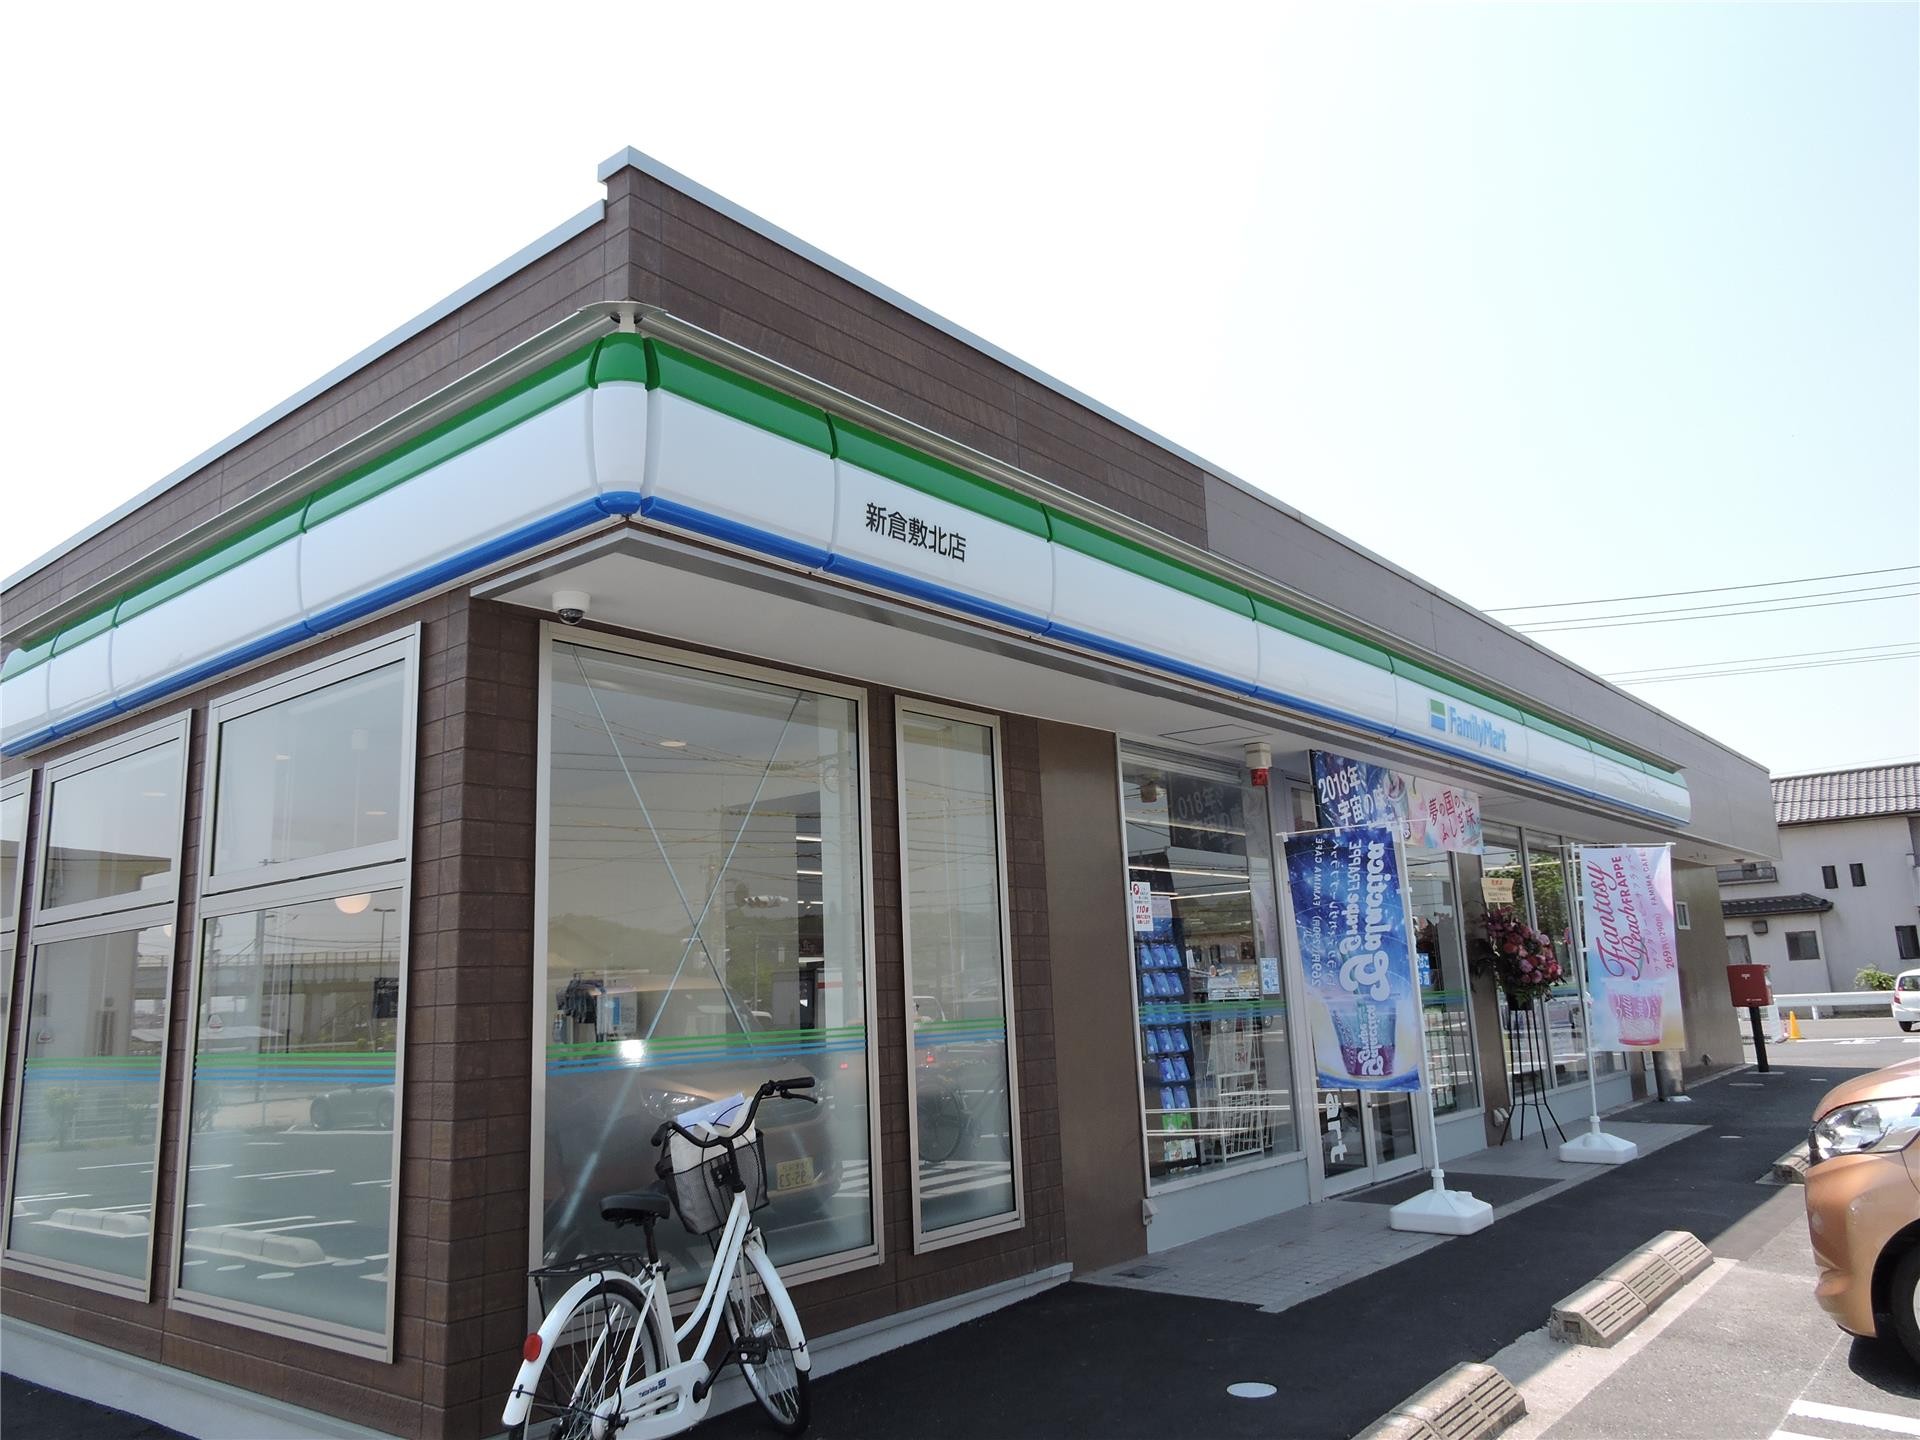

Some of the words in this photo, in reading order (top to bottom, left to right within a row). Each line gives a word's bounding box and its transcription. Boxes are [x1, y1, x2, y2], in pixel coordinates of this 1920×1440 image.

[865, 502, 967, 562] 新倉敷北店
[1448, 705, 1507, 752] FamilyMart
[1611, 855, 1633, 905] FRAPPE
[1587, 859, 1640, 981] Fantasy
[1616, 903, 1650, 965] Peach
